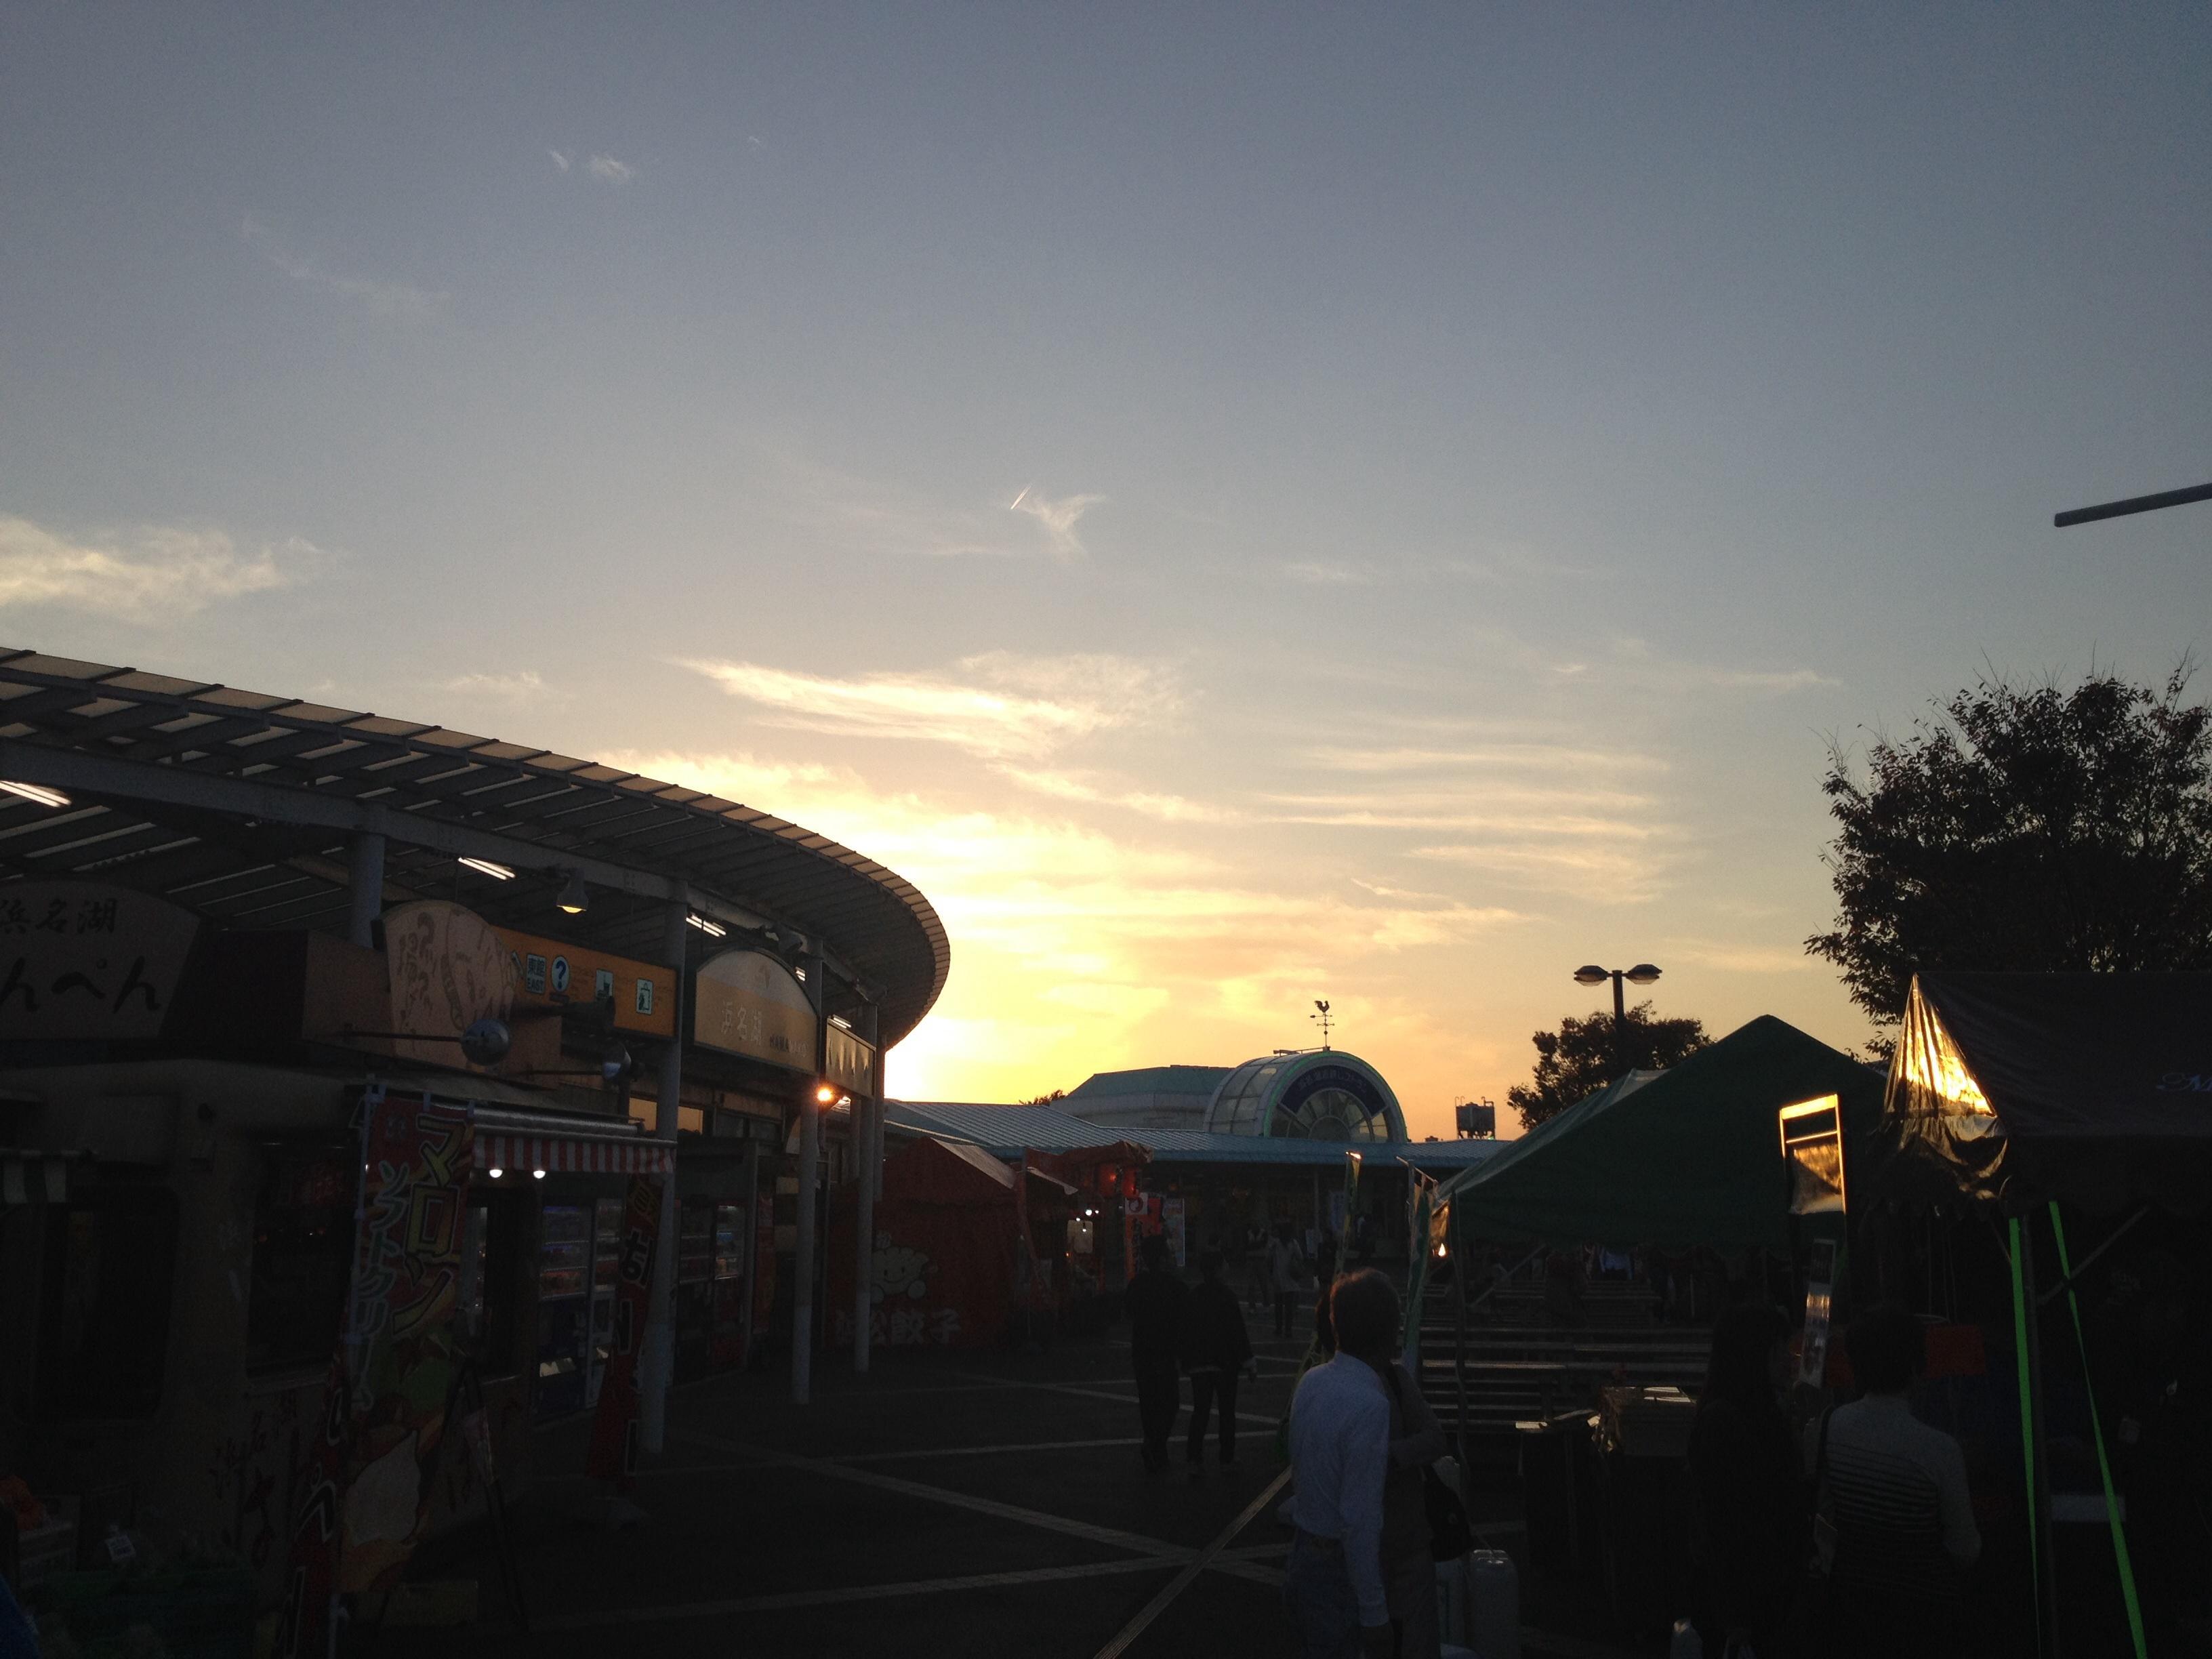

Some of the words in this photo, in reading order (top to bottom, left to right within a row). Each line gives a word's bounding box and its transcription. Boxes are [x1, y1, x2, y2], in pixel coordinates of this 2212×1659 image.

[527, 977, 544, 991] EAST
[392, 1113, 466, 1338] メロン
